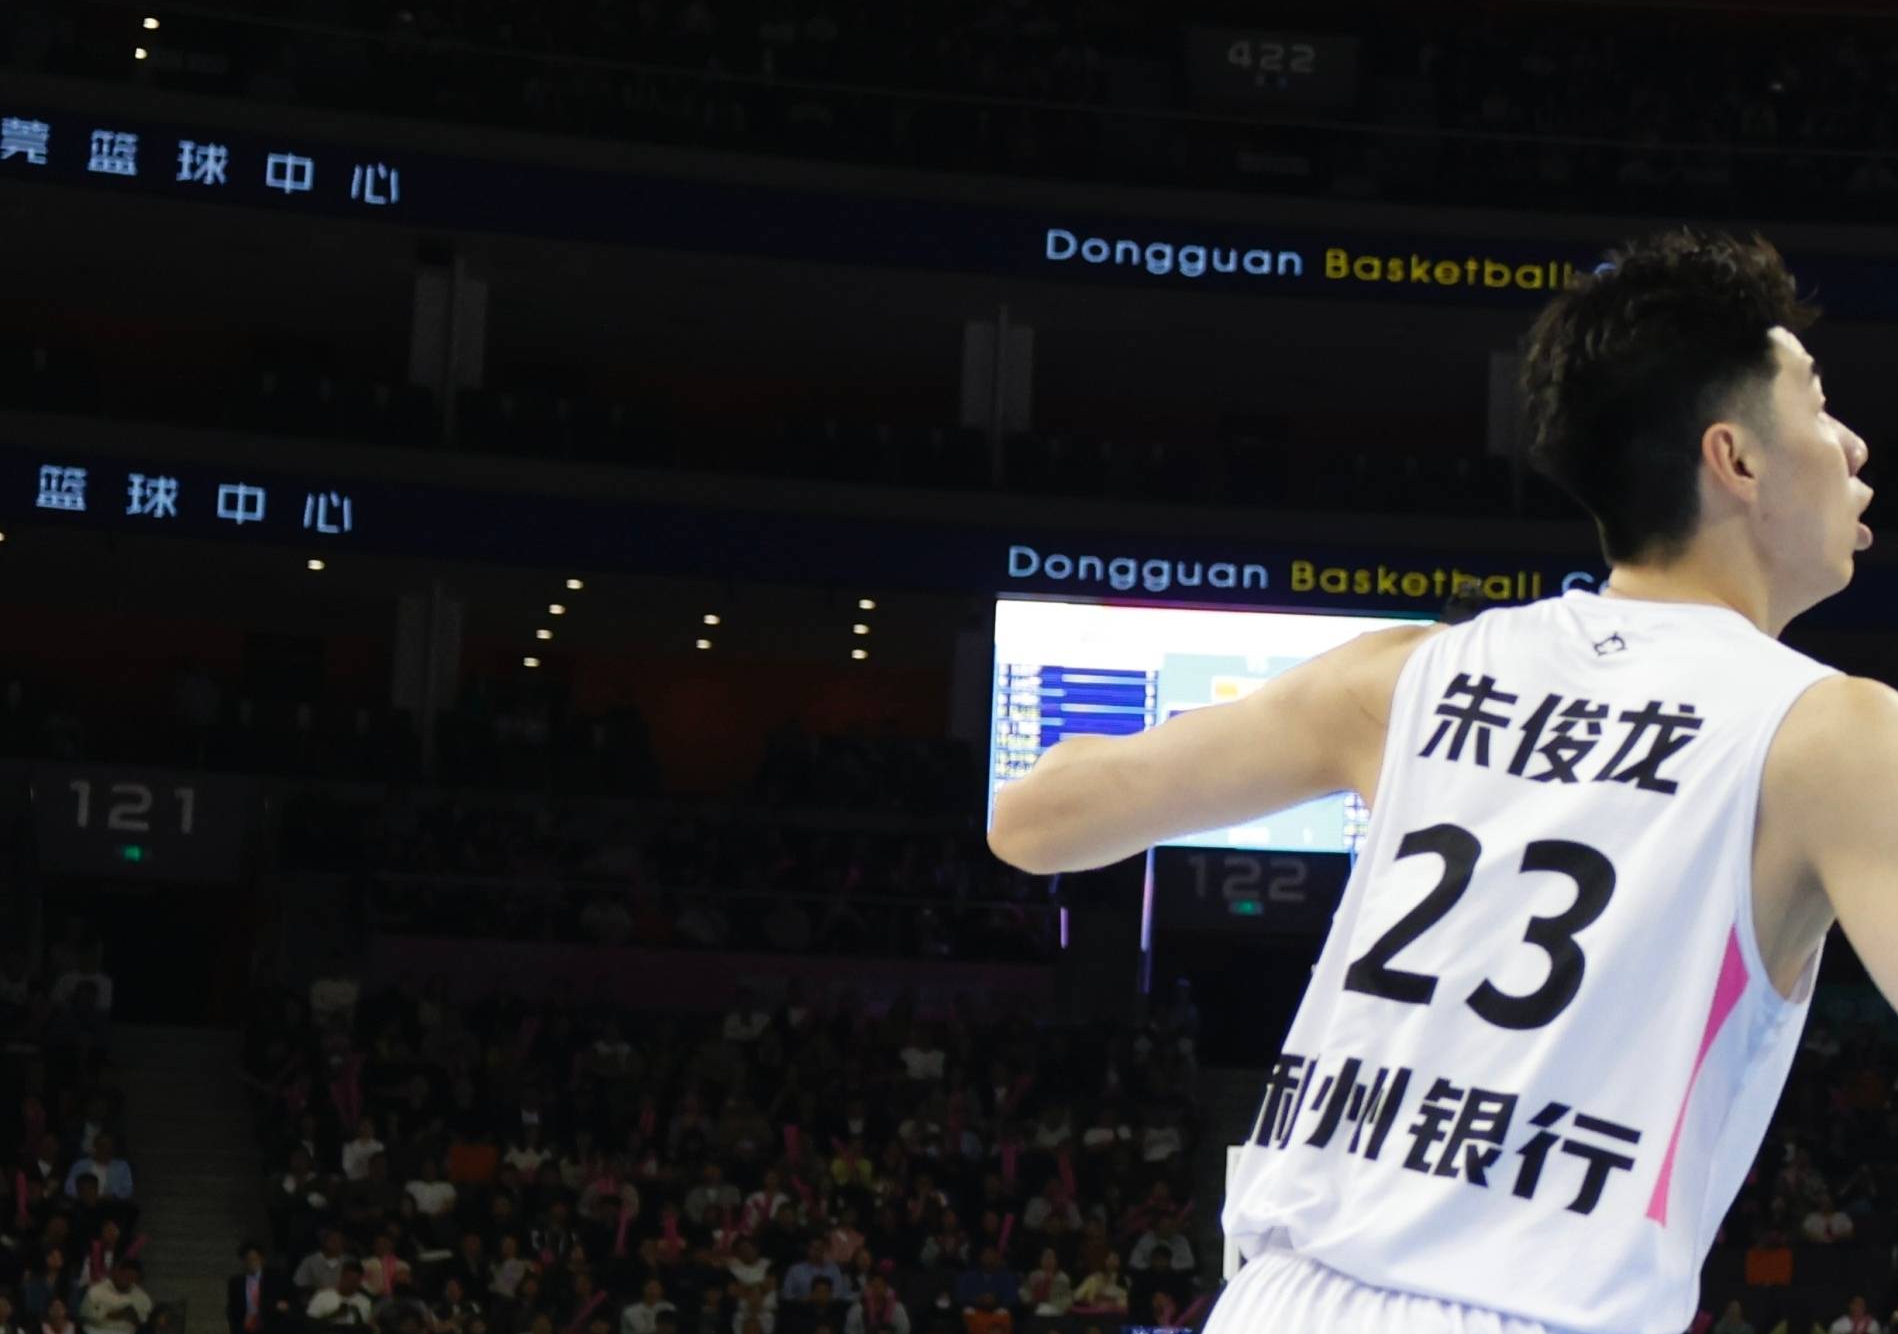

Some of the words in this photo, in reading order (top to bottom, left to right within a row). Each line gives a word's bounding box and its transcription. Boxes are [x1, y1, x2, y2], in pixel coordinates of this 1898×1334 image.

[1226, 40, 1317, 73] 422
[0, 115, 400, 206] 莞篮球中心
[1043, 228, 1305, 278] Dongguan
[1324, 247, 1574, 291] Basketball
[35, 463, 354, 536] 篮球中心
[1006, 544, 1270, 593] Dongguan
[1418, 672, 1704, 796] 朱俊龙
[68, 778, 196, 835] 121
[1189, 855, 1309, 903] 122
[1344, 822, 1618, 1031] 23
